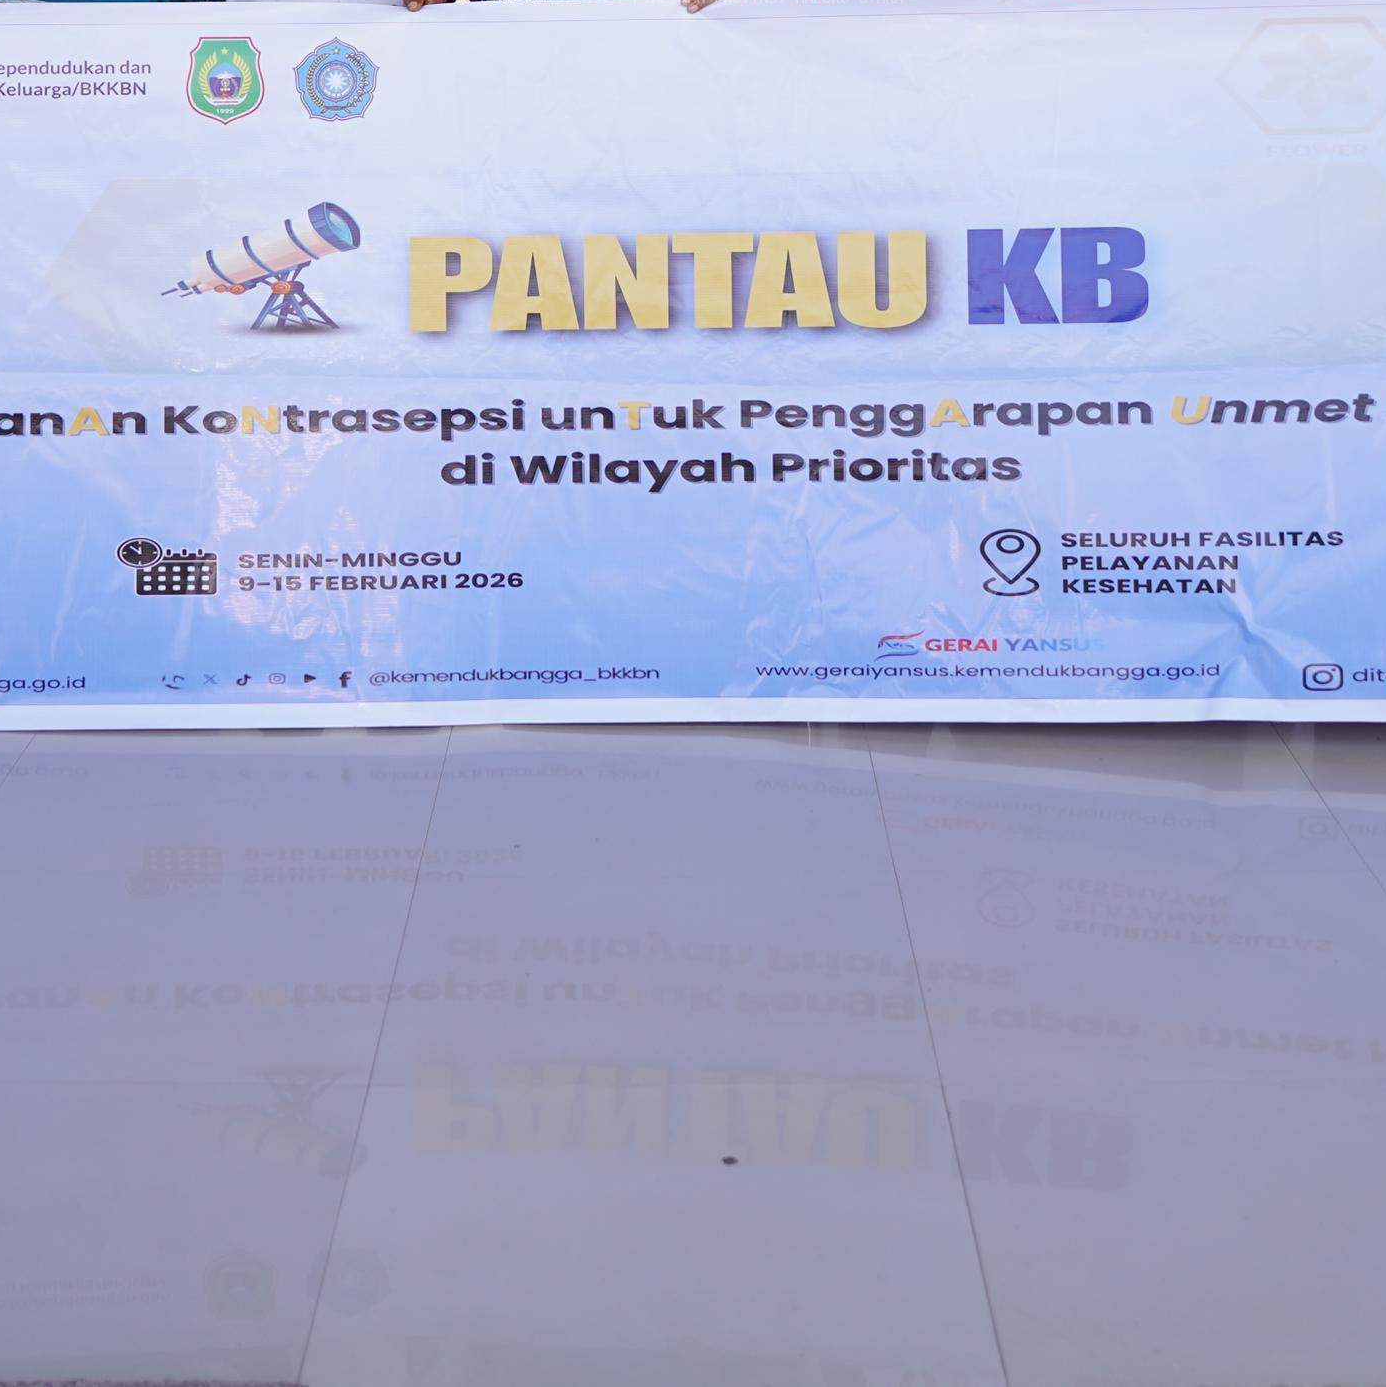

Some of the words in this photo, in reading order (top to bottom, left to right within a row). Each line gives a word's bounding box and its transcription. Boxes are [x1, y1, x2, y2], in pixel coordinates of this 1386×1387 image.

[119, 59, 152, 75] dan
[409, 230, 927, 333] PANTAU
[966, 227, 1150, 325] KB
[163, 398, 527, 442] KoNtrasepsi
[541, 399, 726, 432] unTuk
[739, 397, 1153, 439] PenggArapan
[1169, 392, 1375, 427] Unmet
[441, 452, 495, 487] di
[509, 451, 756, 497] Wilayah
[772, 450, 1024, 484] Prioritas
[1061, 532, 1191, 548] SELURUH
[1199, 530, 1344, 547] FASILITAS
[238, 551, 462, 569] SENIN-MINGGU
[1062, 555, 1239, 571] PELAYANAN
[238, 576, 302, 591] 9-15
[310, 574, 447, 591] FEBRUARI
[454, 572, 524, 589] 2026
[1062, 577, 1237, 594] KESEHATAN
[924, 638, 998, 653] GERAI
[1004, 637, 1105, 652] YANSUS
[369, 666, 660, 686] @kemendukbangga_bkkbn
[755, 663, 1221, 681] www.geraiyansus.kemendukbangga.go.id
